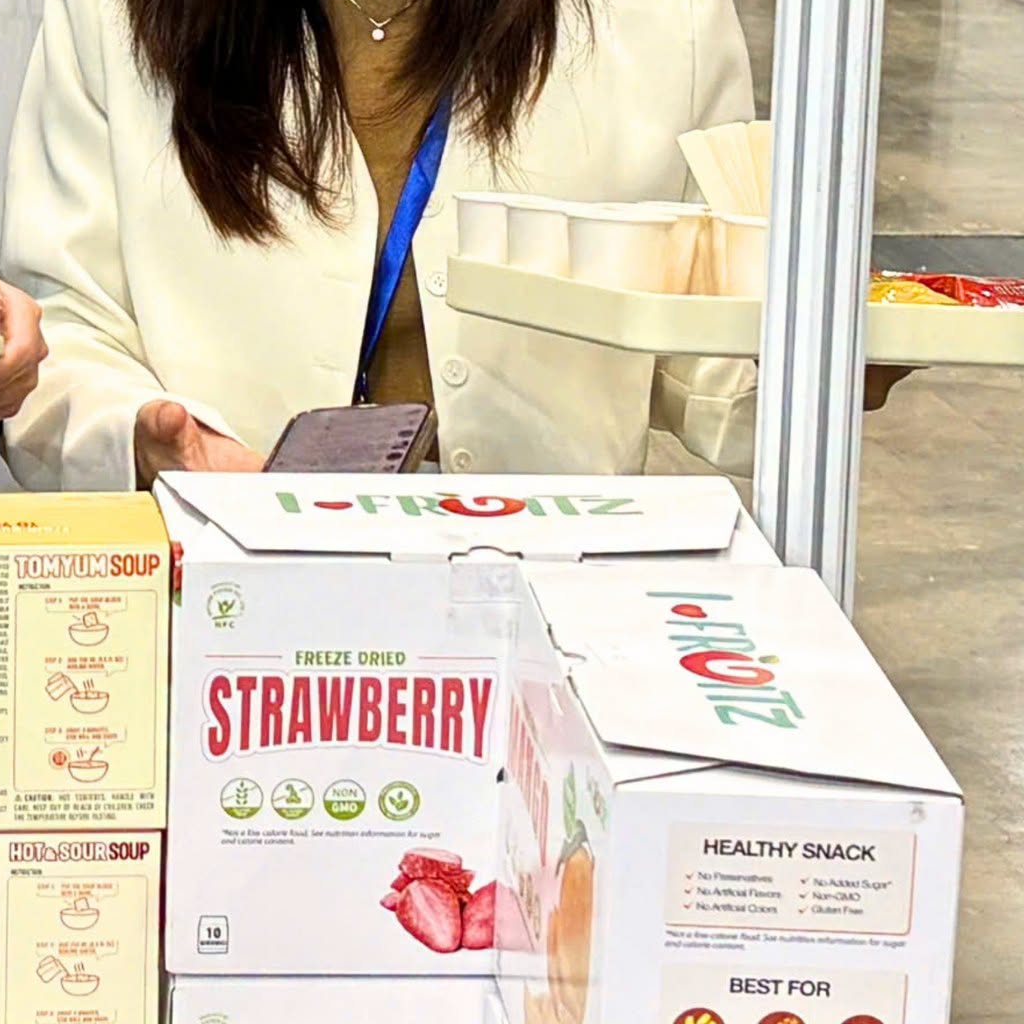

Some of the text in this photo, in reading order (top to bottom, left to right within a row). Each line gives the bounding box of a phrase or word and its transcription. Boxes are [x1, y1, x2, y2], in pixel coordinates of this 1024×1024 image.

[14, 553, 161, 578] TOMYUM SOUP
[294, 650, 406, 667] FREEZE DRIED
[207, 674, 493, 760] STRAWBERRY
[332, 787, 358, 799] NON
[331, 803, 359, 814] GMO
[108, 842, 150, 861] SOUP
[703, 838, 876, 863] HEALTHY SNACK
[697, 871, 712, 881] No
[813, 878, 828, 888] No
[697, 886, 712, 896] No
[696, 901, 711, 911] No
[206, 927, 222, 939] 10
[729, 977, 832, 999] BEST FOR
